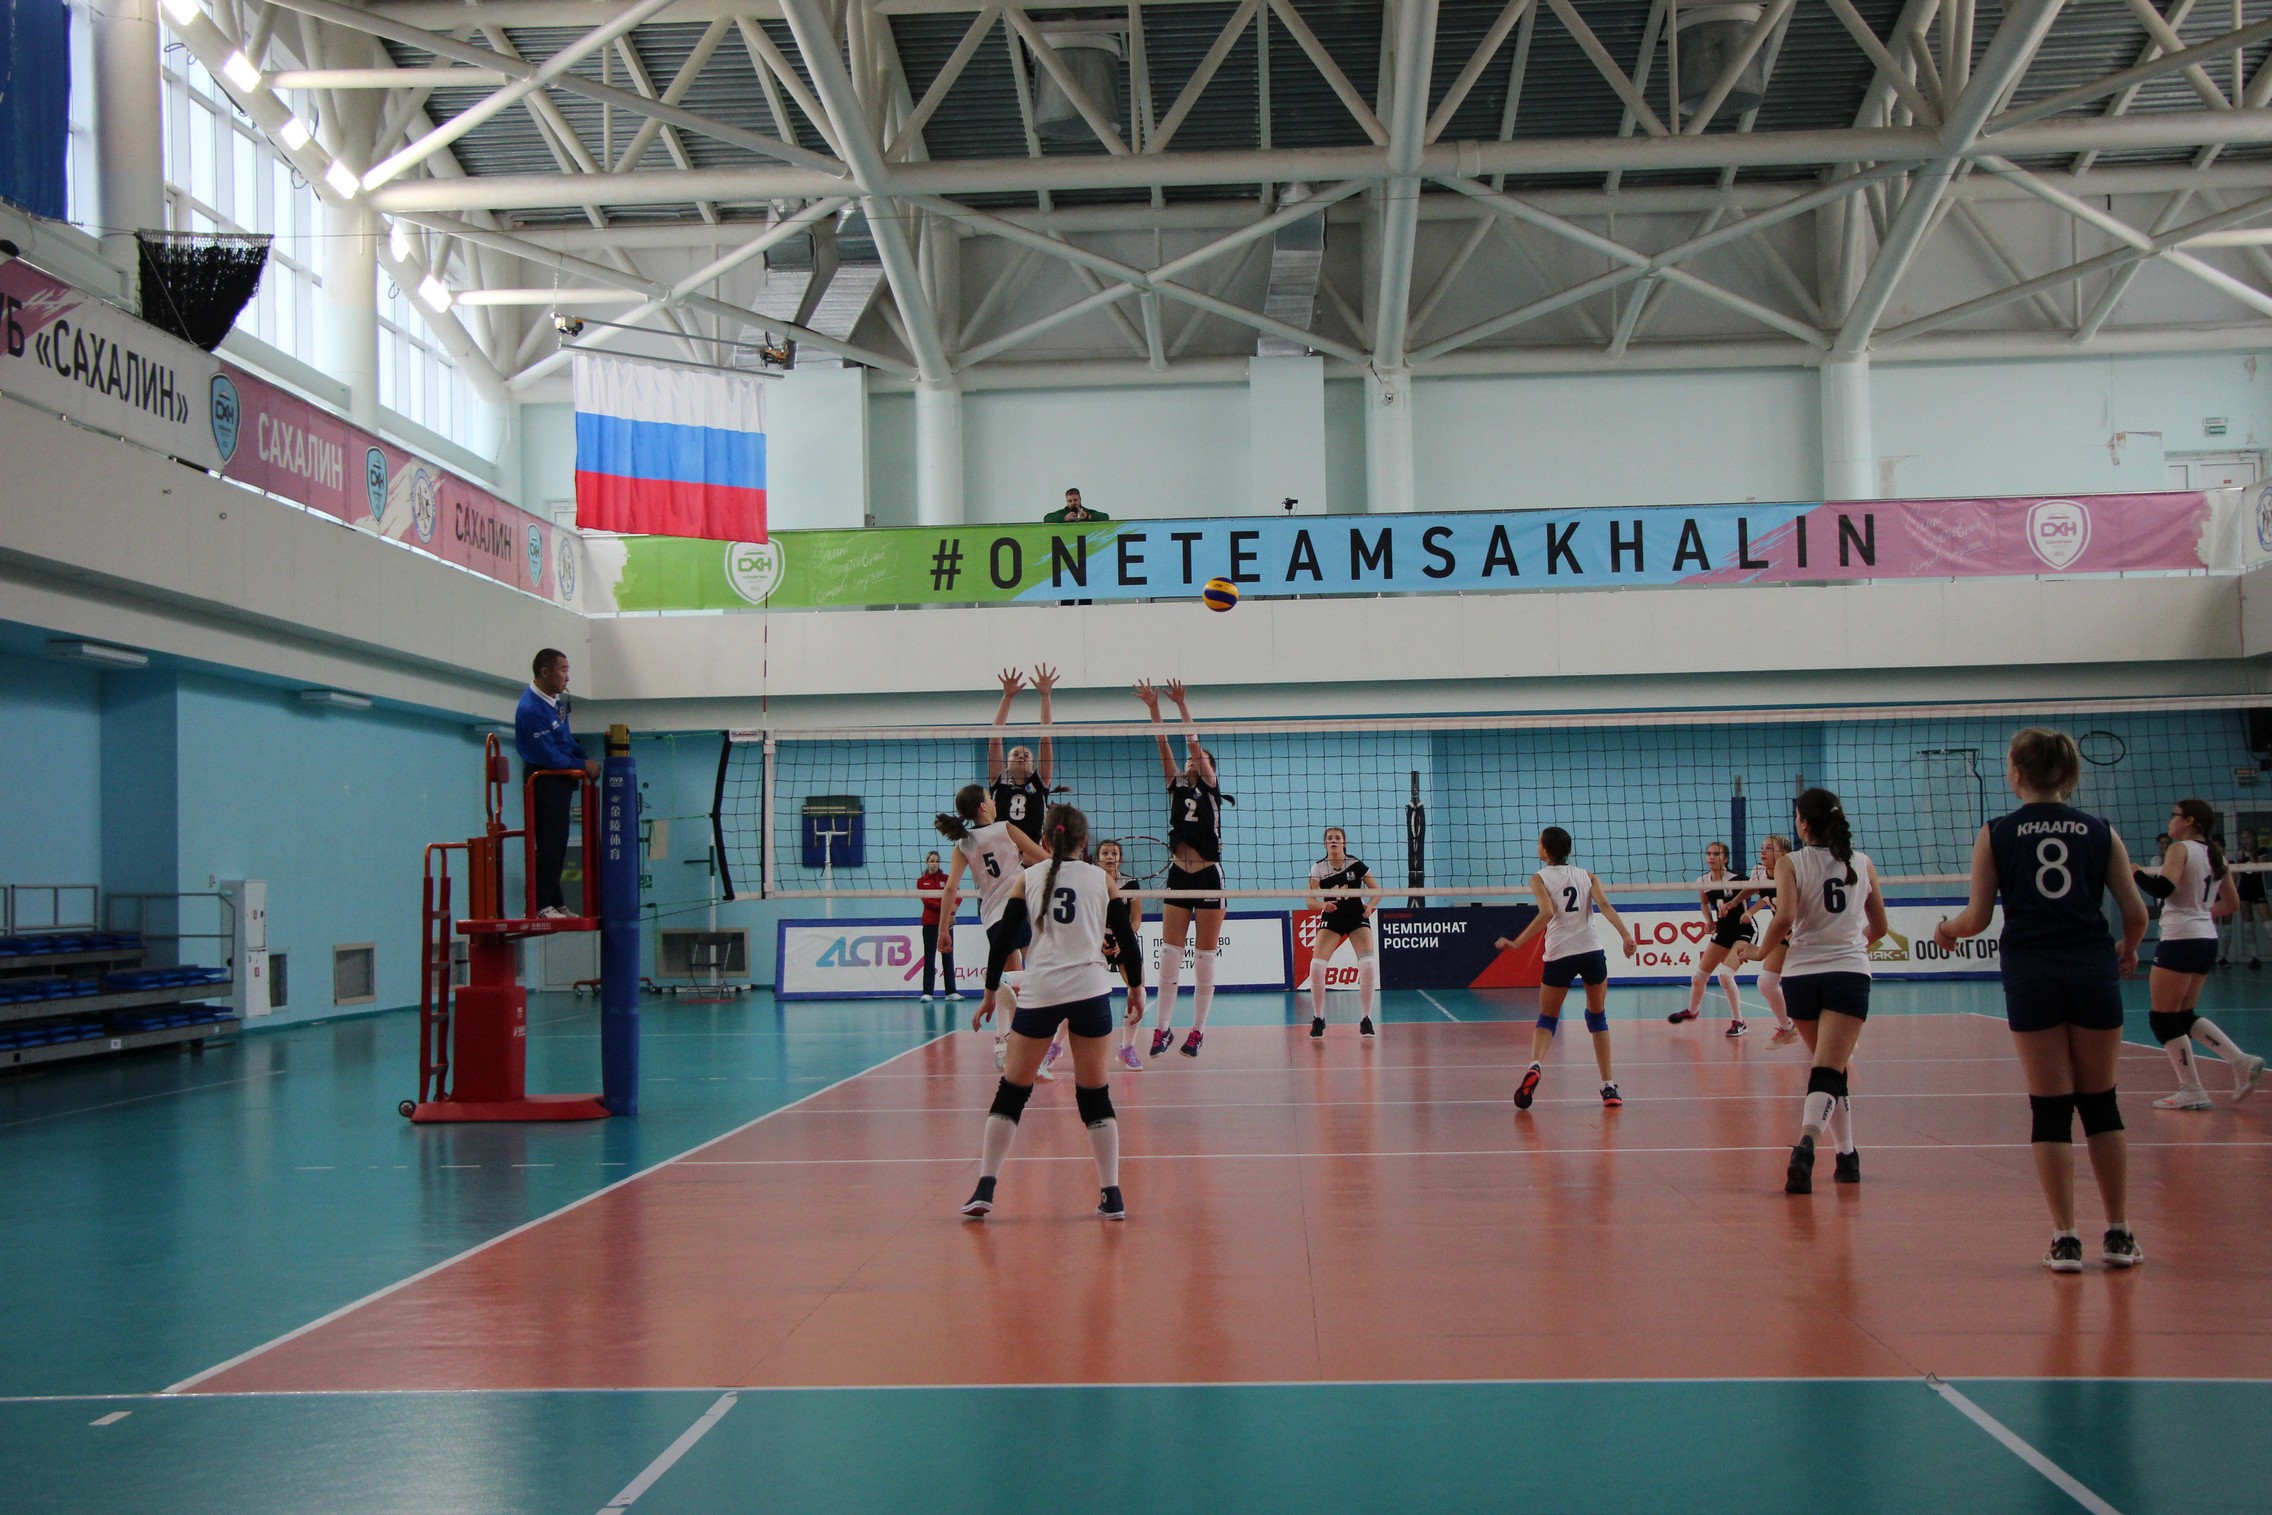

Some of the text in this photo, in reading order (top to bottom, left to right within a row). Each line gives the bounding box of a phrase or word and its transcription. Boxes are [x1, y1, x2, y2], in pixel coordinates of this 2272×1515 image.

[36, 319, 189, 424] «САХАЛИН»
[258, 412, 343, 492] САХАЛИН
[455, 503, 512, 563] САХАЛИН
[1009, 794, 1026, 821] 8
[1184, 798, 1199, 822] 2
[2017, 820, 2088, 837] КНААПО
[982, 852, 1000, 879] 5
[2035, 837, 2072, 899] 8
[1053, 887, 1076, 924] 3
[1563, 886, 1579, 912] 2
[1823, 877, 1847, 914] 6
[1382, 921, 1468, 935] ЧЕМПИОНАТ
[1384, 936, 1440, 950] РОССИИ
[1635, 951, 1691, 967] 104.4
